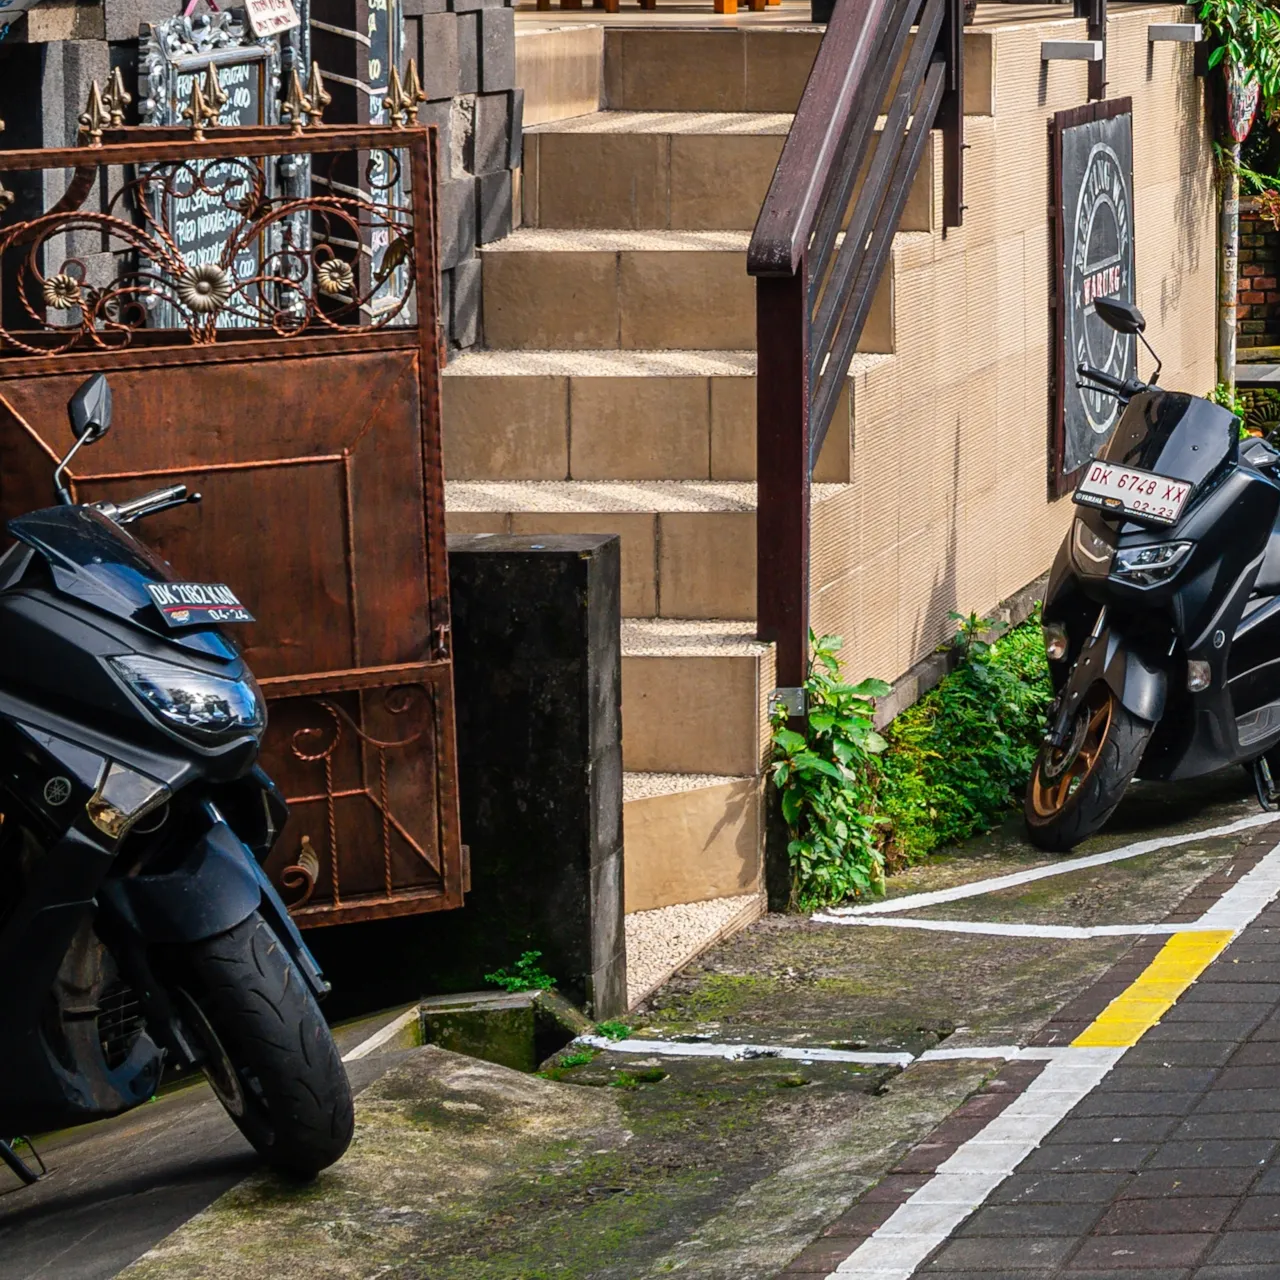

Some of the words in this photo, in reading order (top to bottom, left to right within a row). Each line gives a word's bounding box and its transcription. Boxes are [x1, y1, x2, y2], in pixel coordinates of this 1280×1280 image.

[1090, 467, 1113, 486] DK
[1117, 474, 1158, 496] 6748
[1161, 484, 1185, 503] XX
[148, 584, 180, 605] DK
[172, 585, 212, 604] 2182
